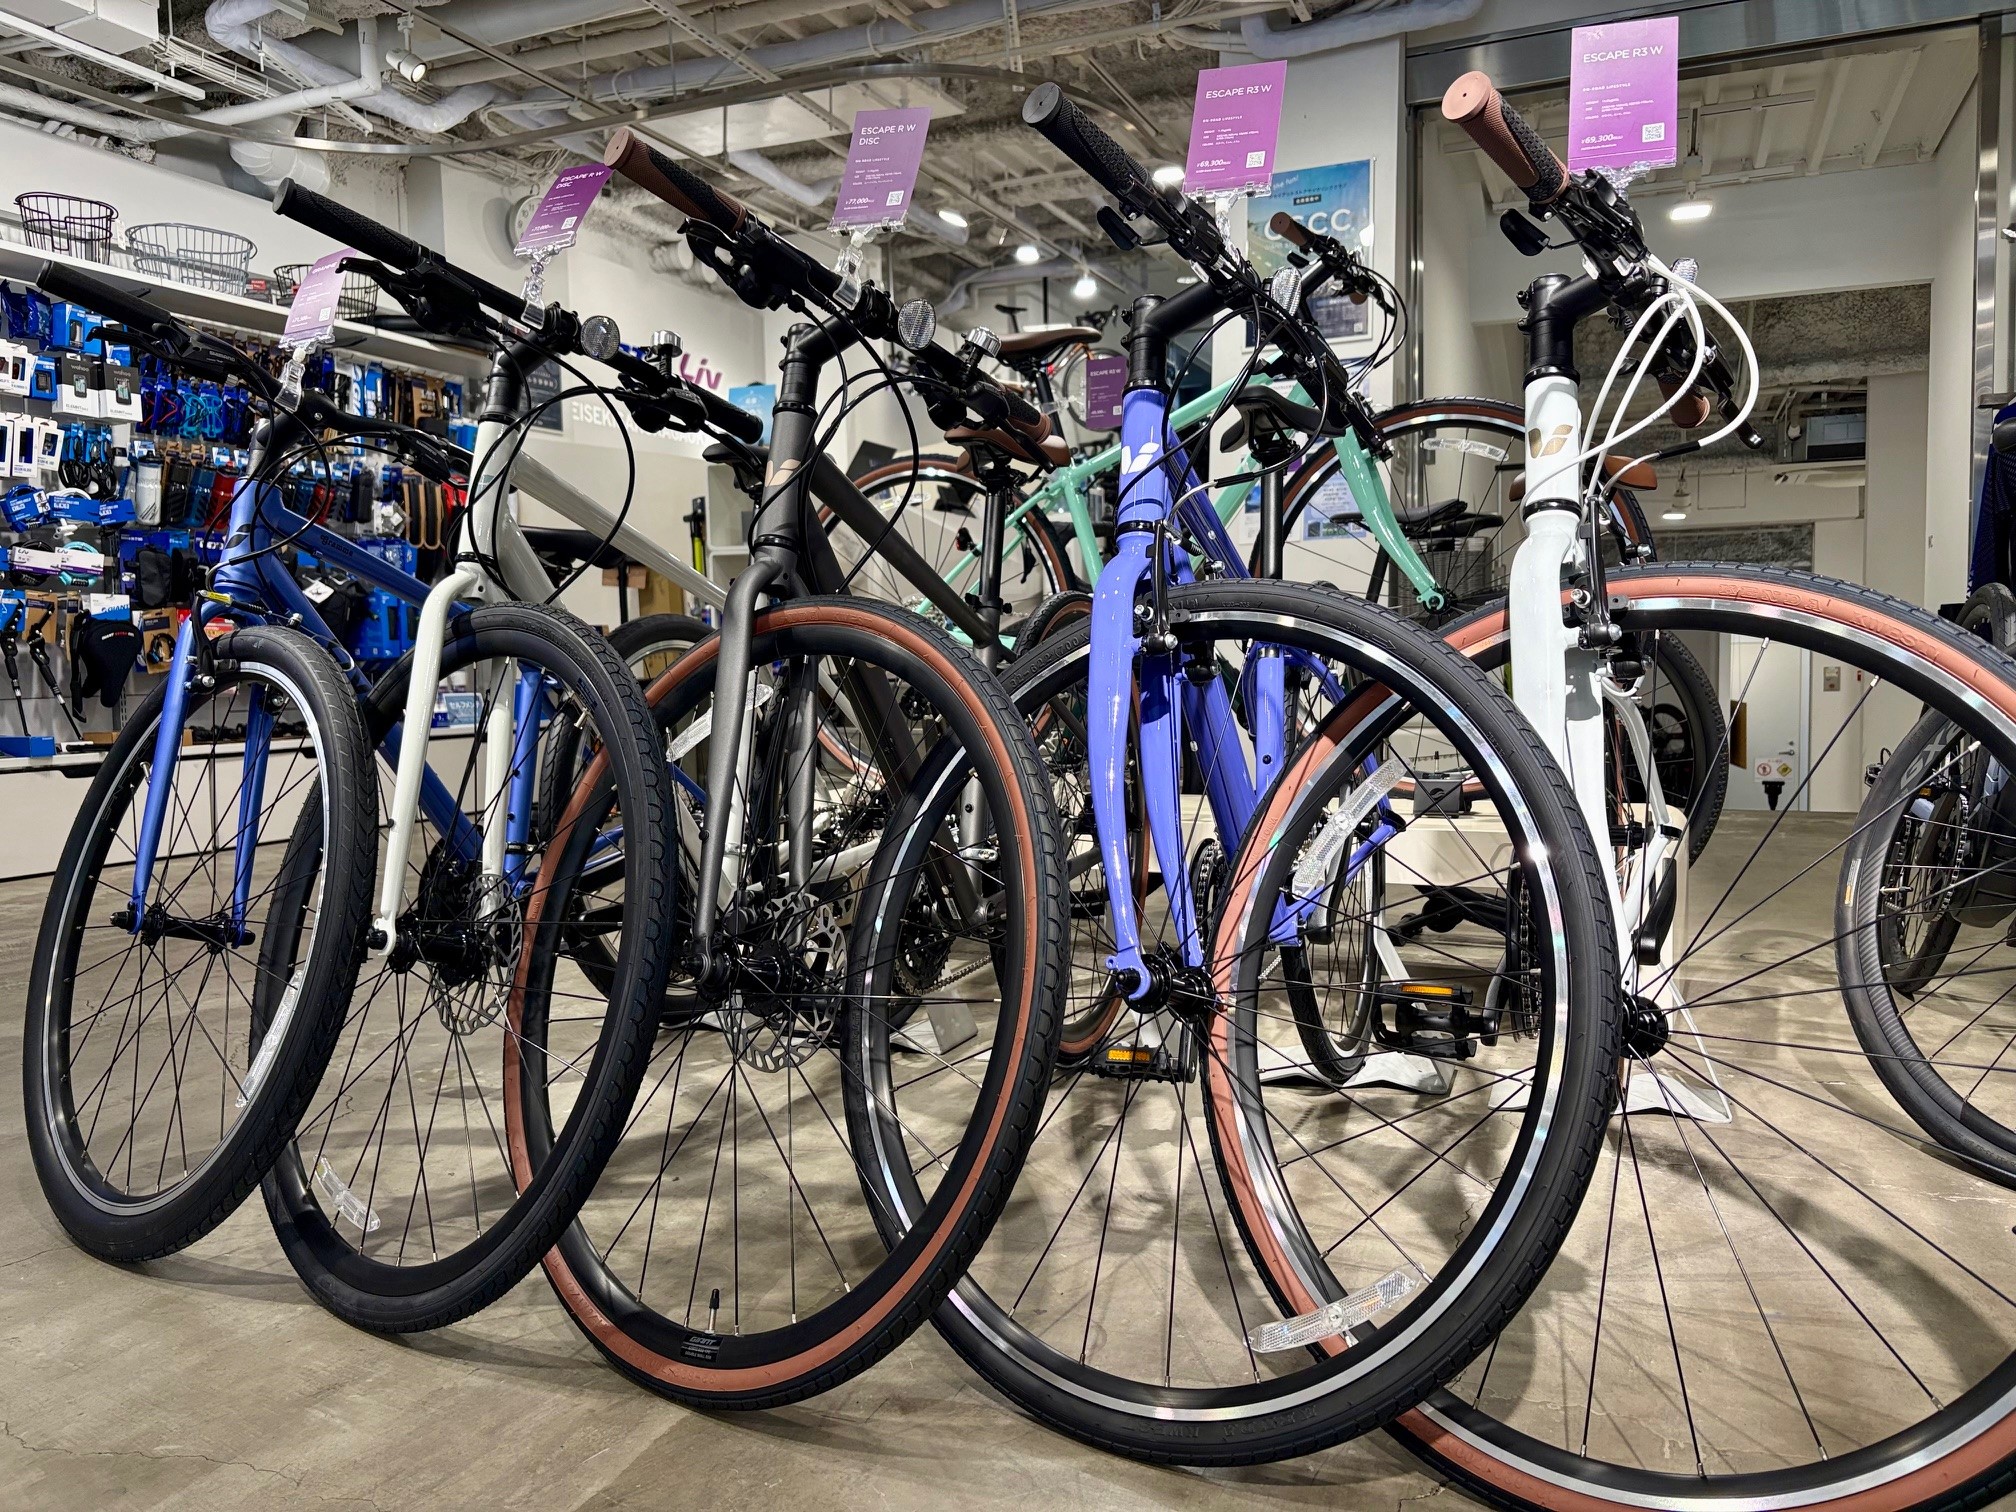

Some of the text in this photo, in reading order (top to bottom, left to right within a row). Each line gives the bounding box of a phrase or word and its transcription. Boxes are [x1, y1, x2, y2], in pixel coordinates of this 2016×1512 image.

[1583, 45, 1664, 64] ESCAPE R3 W
[1205, 84, 1272, 99] ESCAPE R3 W
[861, 124, 917, 135] ESCAPE R W
[859, 137, 880, 146] DISC
[560, 173, 589, 182] ESCAPE
[555, 181, 573, 189] DISC
[71, 364, 90, 372] wahoo
[680, 353, 723, 390] Liv
[1090, 369, 1109, 377] ESCAPE
[1719, 583, 1823, 612] KENDA
[107, 604, 129, 612] GIANT
[689, 1336, 717, 1346] GIANT
